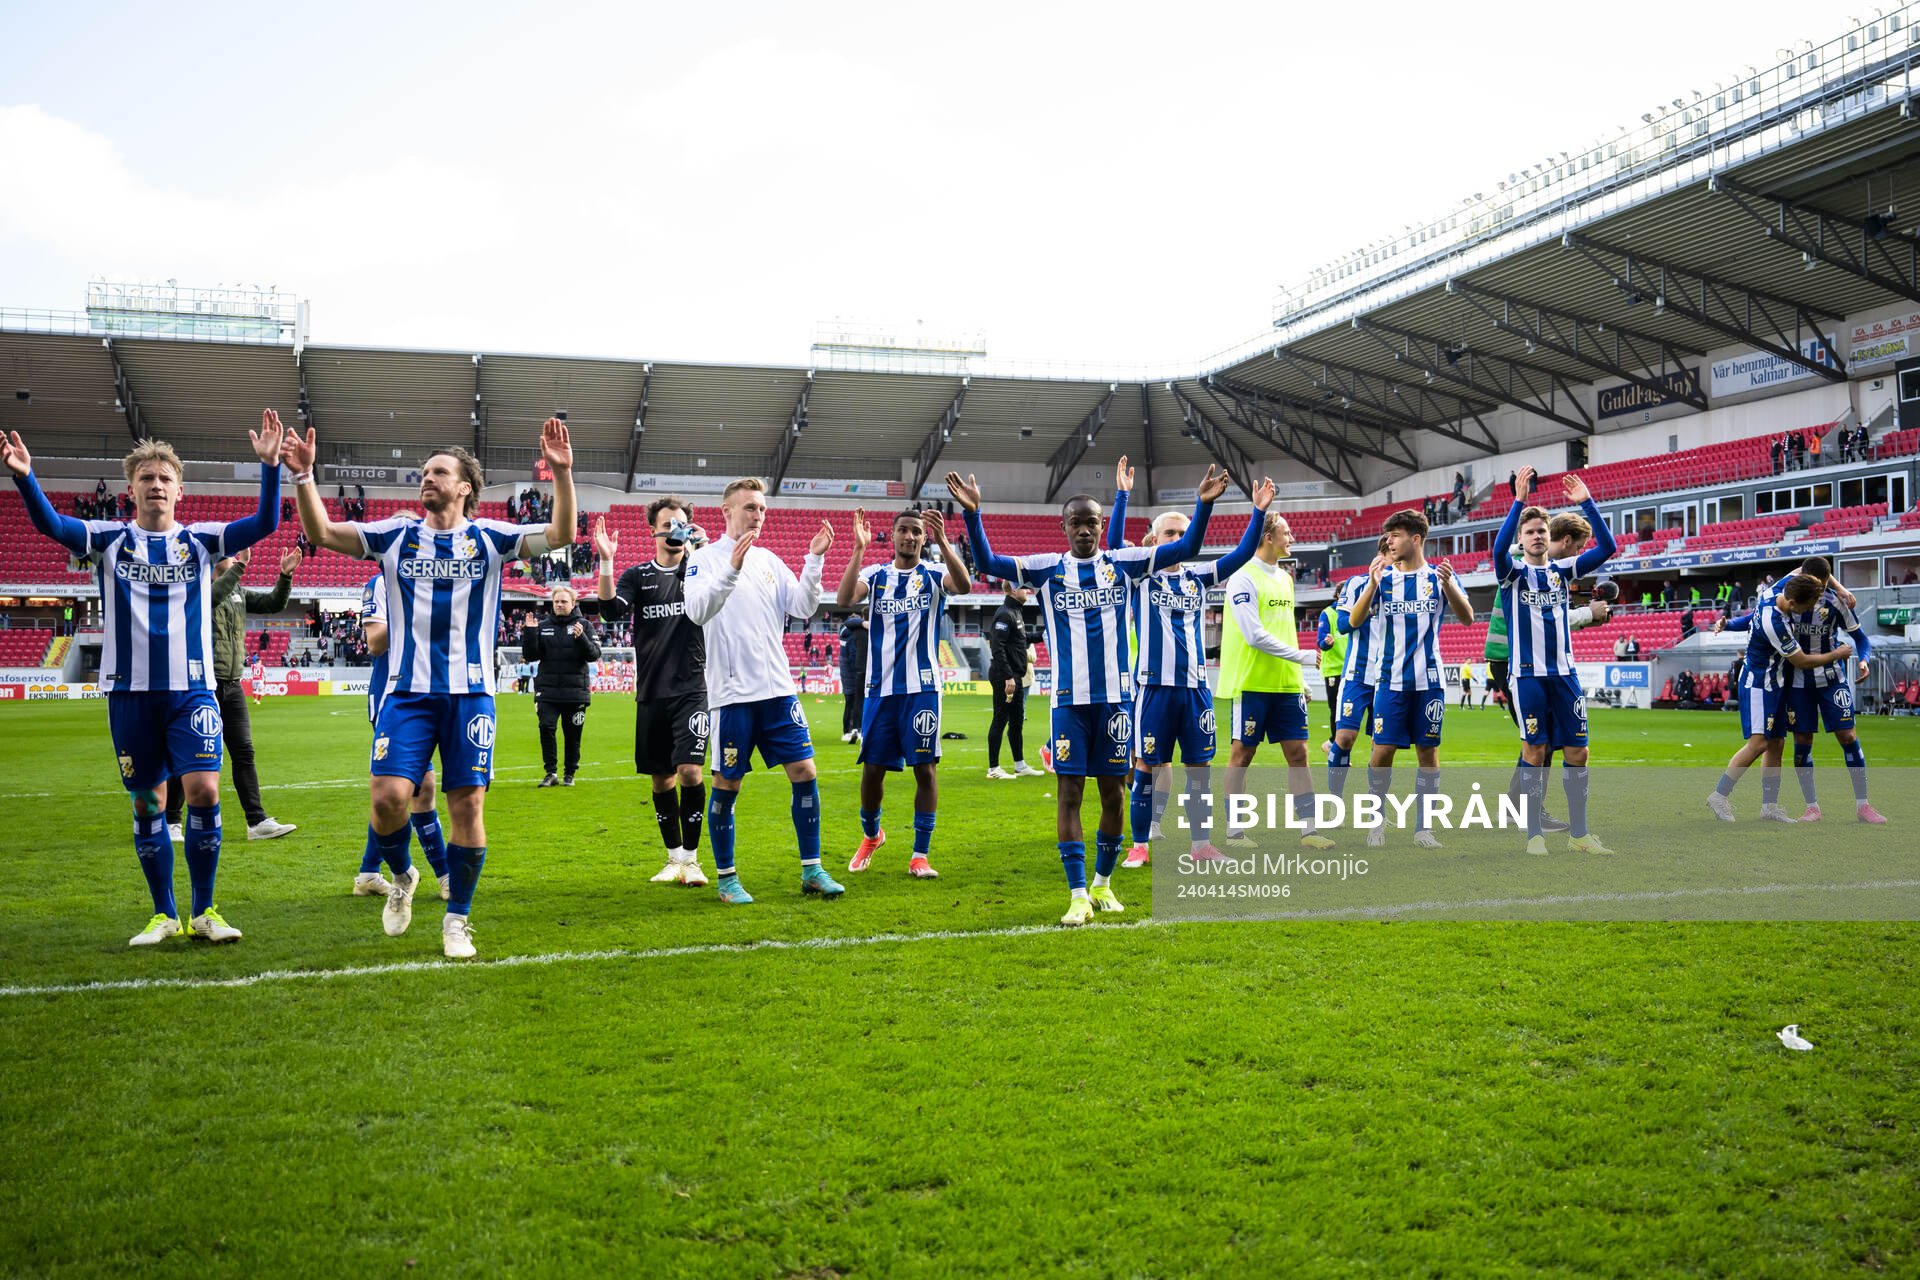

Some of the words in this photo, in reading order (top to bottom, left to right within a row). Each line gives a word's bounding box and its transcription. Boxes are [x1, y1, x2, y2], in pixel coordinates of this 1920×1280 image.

[1750, 368, 1790, 386] Kalmar
[335, 468, 387, 478] inside
[791, 481, 807, 490] IVT
[117, 562, 197, 583] SERNEKE
[401, 559, 484, 579] SERNEKE
[875, 594, 931, 614] SERNEKE
[1055, 587, 1125, 610] SERNEKE
[1384, 600, 1438, 614] SERNEKE
[1835, 690, 1851, 707] MG
[572, 711, 586, 725] MG
[1426, 700, 1444, 722] MG
[193, 708, 220, 735] MG
[690, 713, 709, 736] MG
[915, 710, 936, 735] MG
[1109, 714, 1131, 741] MG
[1429, 723, 1439, 734] 36
[470, 716, 495, 746] MG
[203, 738, 216, 752] 15
[695, 738, 705, 750] 25
[922, 737, 930, 748] 11
[1115, 744, 1127, 757] 30
[478, 751, 488, 766] 13
